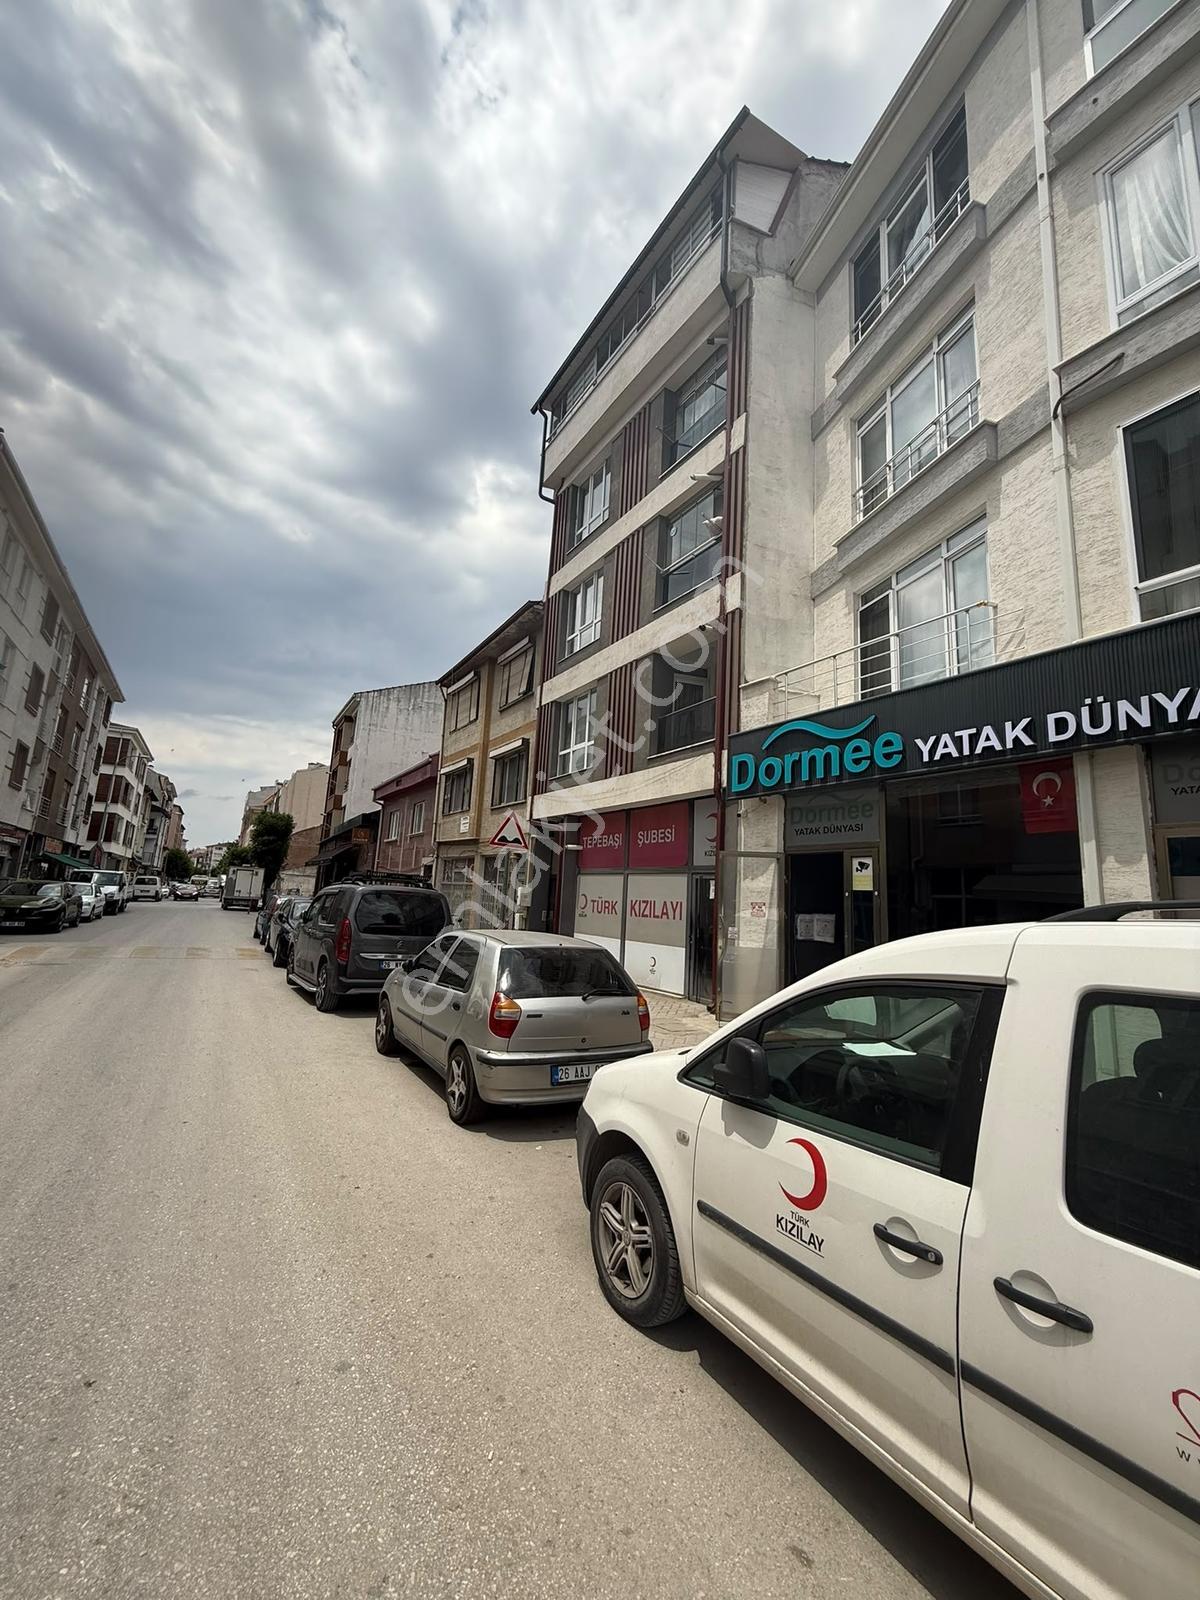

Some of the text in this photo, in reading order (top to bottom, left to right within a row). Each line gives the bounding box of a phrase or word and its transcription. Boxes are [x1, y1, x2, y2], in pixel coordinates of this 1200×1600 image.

[731, 732, 904, 792] Dormee
[914, 717, 1037, 762] YATAK
[790, 801, 875, 824] Dormee
[582, 825, 676, 849] TEPEBAŞI ŞUBESİ
[794, 823, 864, 836] YATAK DÜNYASI
[590, 896, 683, 921] TÜRK KIZILAYI
[559, 1067, 570, 1080] 26
[574, 1066, 591, 1079] AAJ
[790, 1210, 810, 1228] TÜRK
[776, 1213, 825, 1252] KIZILAY
